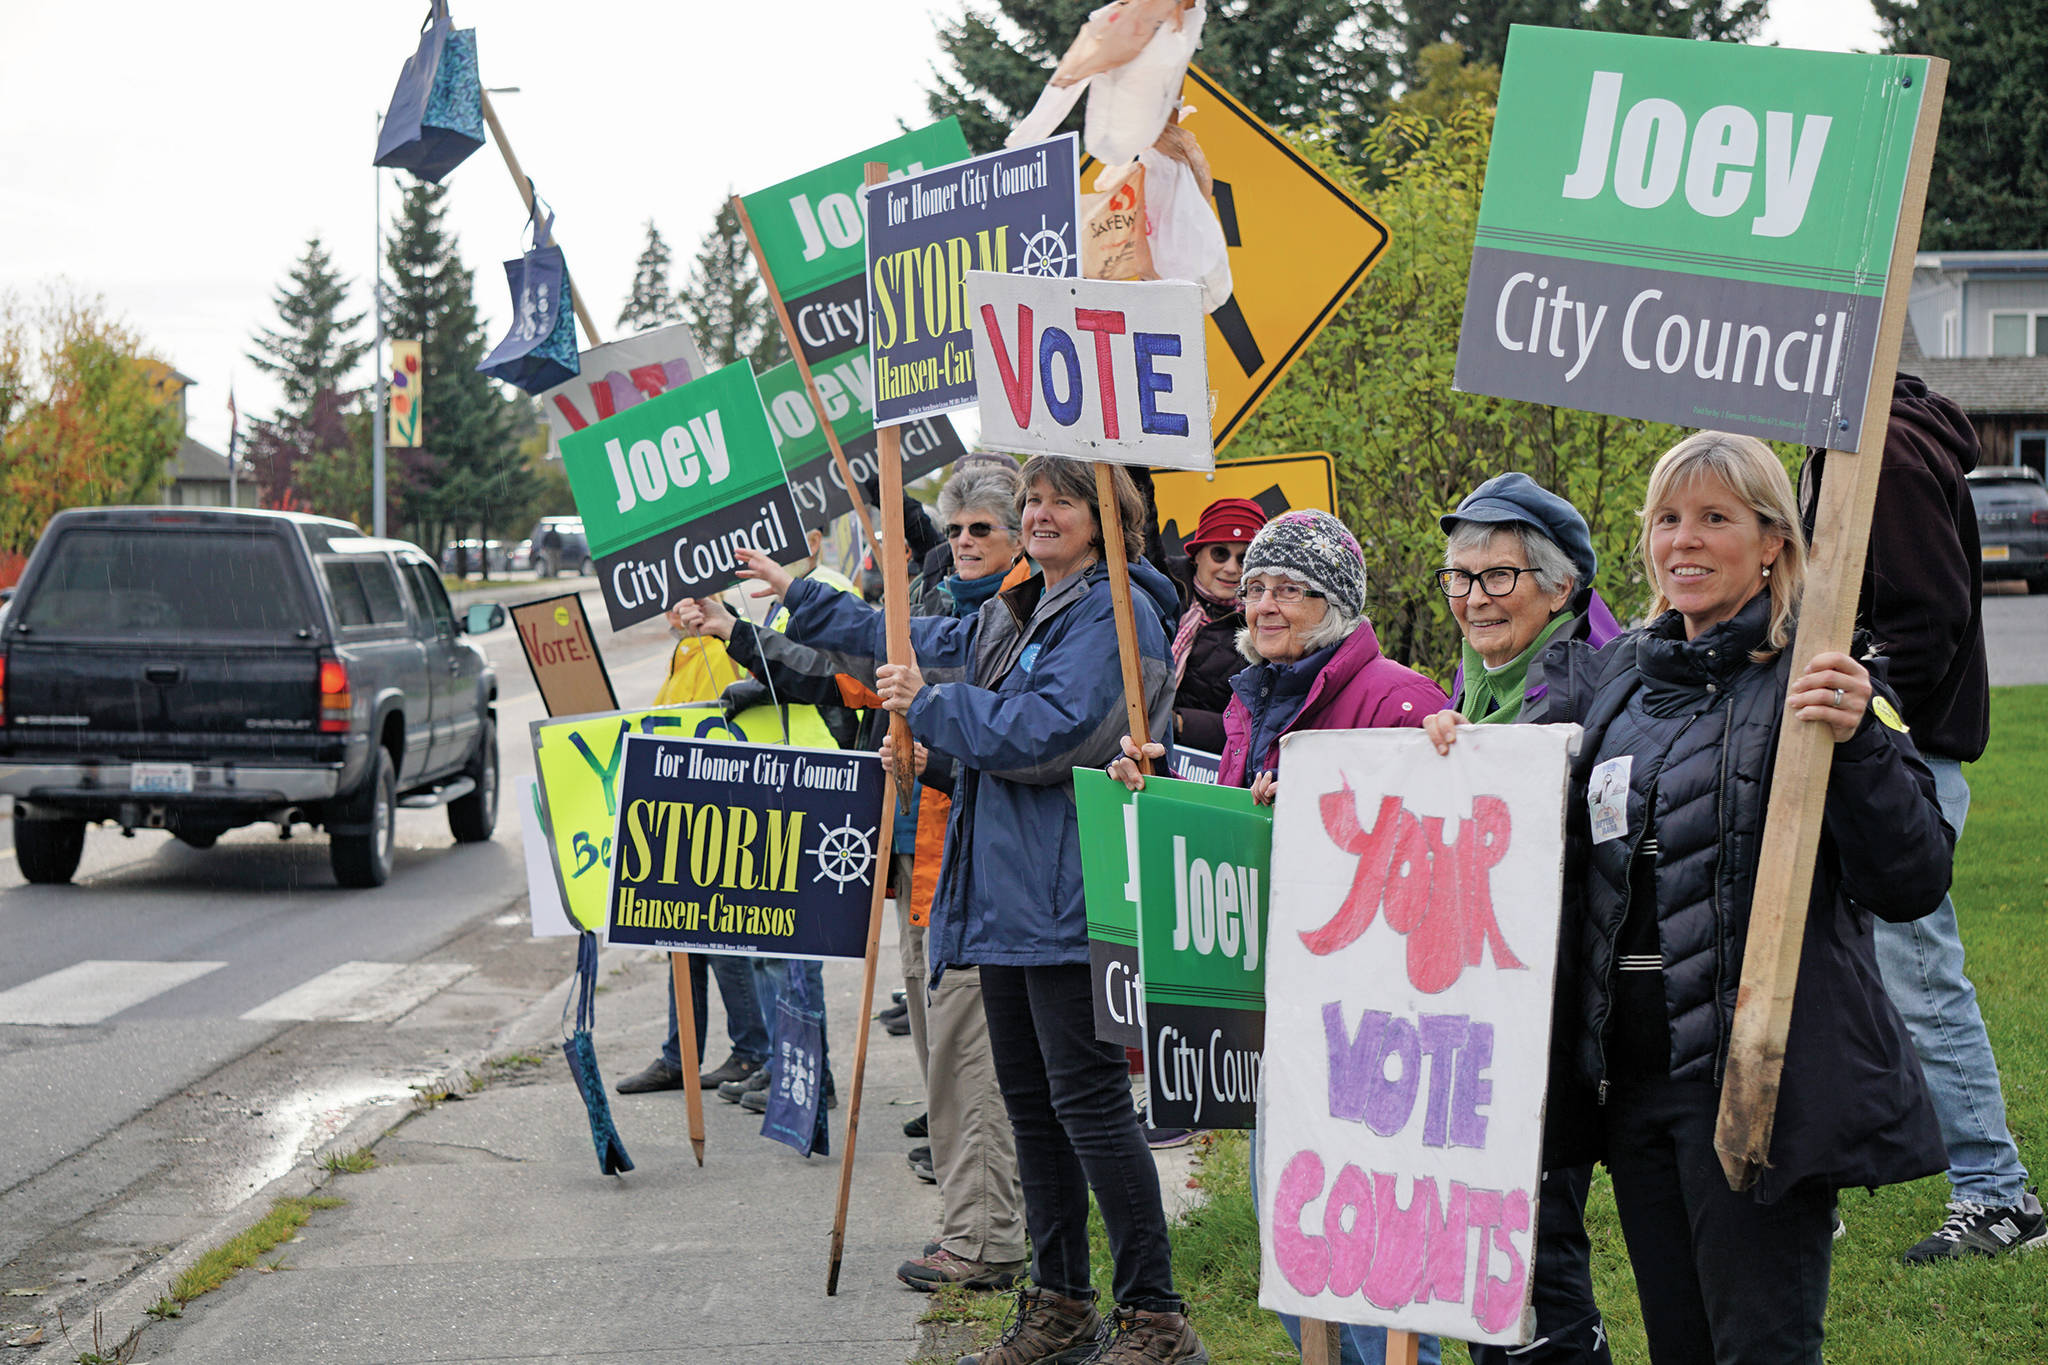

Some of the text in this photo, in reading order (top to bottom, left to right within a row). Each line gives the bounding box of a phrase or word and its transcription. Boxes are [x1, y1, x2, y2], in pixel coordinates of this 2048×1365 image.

[887, 151, 1048, 227] for Homer City Council
[1562, 70, 1833, 238] Joey
[1091, 211, 1137, 239] SAFEW
[797, 298, 862, 348] City
[877, 341, 978, 403] Hansen-Cav
[980, 303, 1190, 441] VOTE
[1496, 272, 1847, 397] City Council
[766, 355, 873, 448] oey
[604, 408, 731, 515] Joey
[612, 554, 670, 611] City
[673, 500, 790, 586] Council
[520, 619, 591, 667] VOTE!
[654, 745, 860, 793] for Homer City Council
[620, 798, 807, 894] STORM
[1296, 768, 1531, 995] YOUR
[615, 886, 796, 937] Hansen-Cavasos
[1172, 834, 1259, 972] Joey
[1105, 960, 1144, 1029] Cit
[1157, 1024, 1263, 1124] City Coun
[1321, 1000, 1495, 1151] VOTE
[1273, 1148, 1531, 1336] COUNTS
